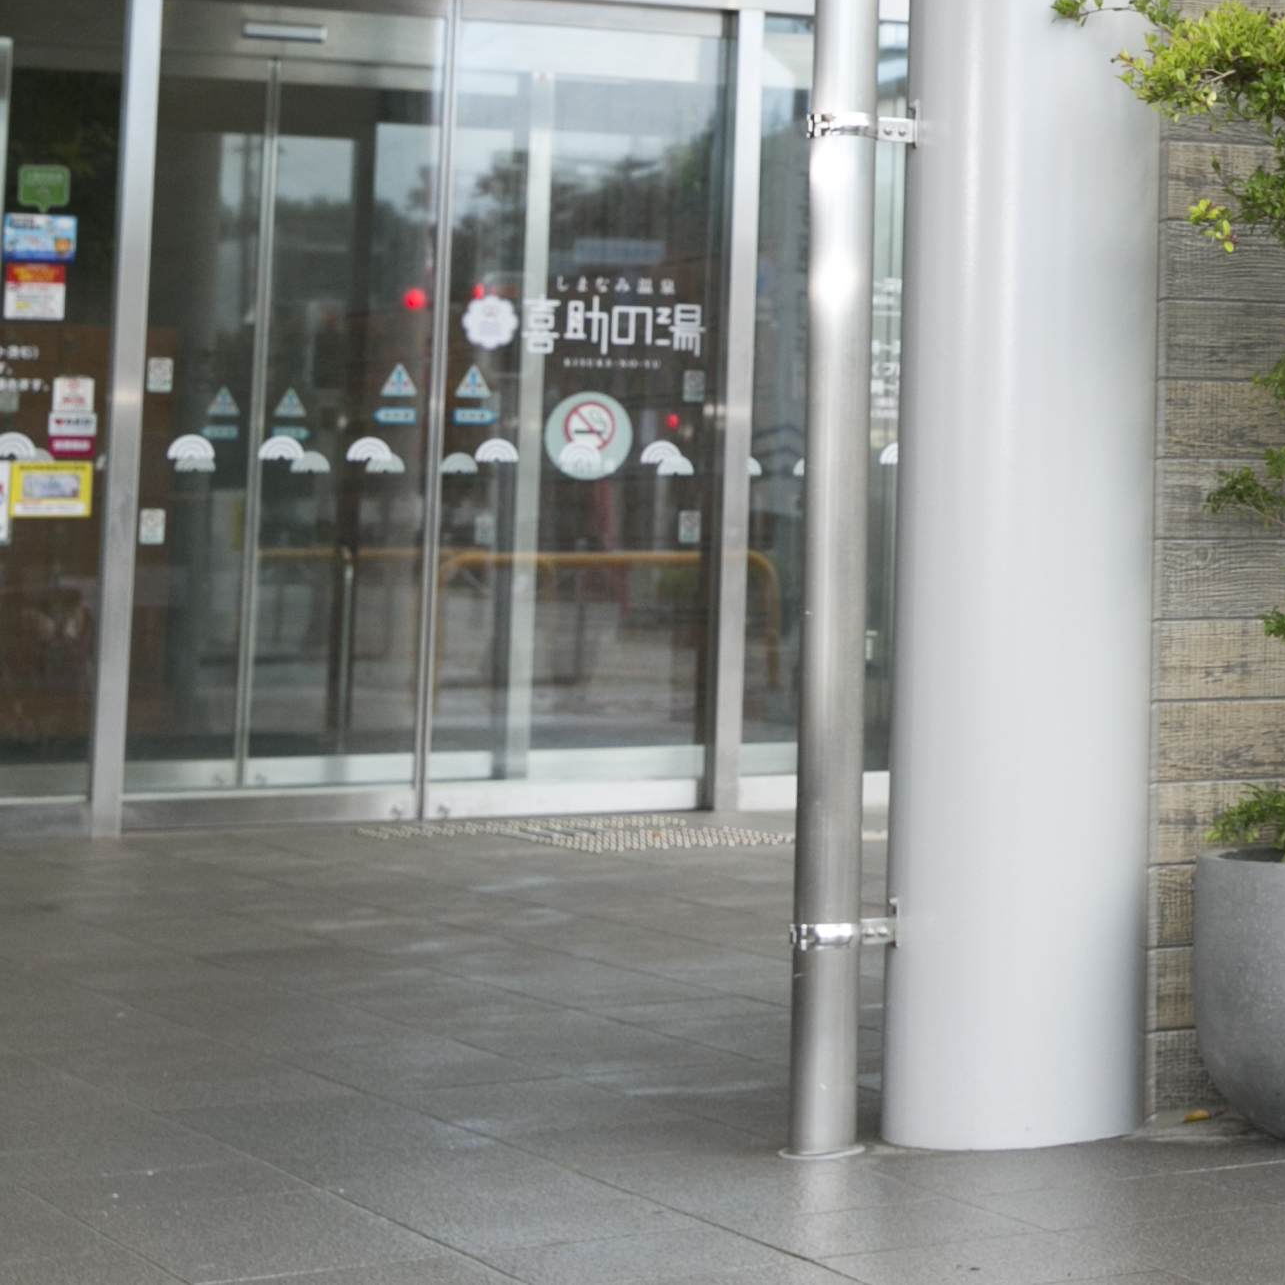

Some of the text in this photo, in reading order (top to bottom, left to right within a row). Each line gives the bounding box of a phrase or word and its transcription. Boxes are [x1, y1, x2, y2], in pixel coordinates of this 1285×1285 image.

[556, 275, 676, 295] しまなみ温泉
[523, 295, 706, 358] 喜助の湯
